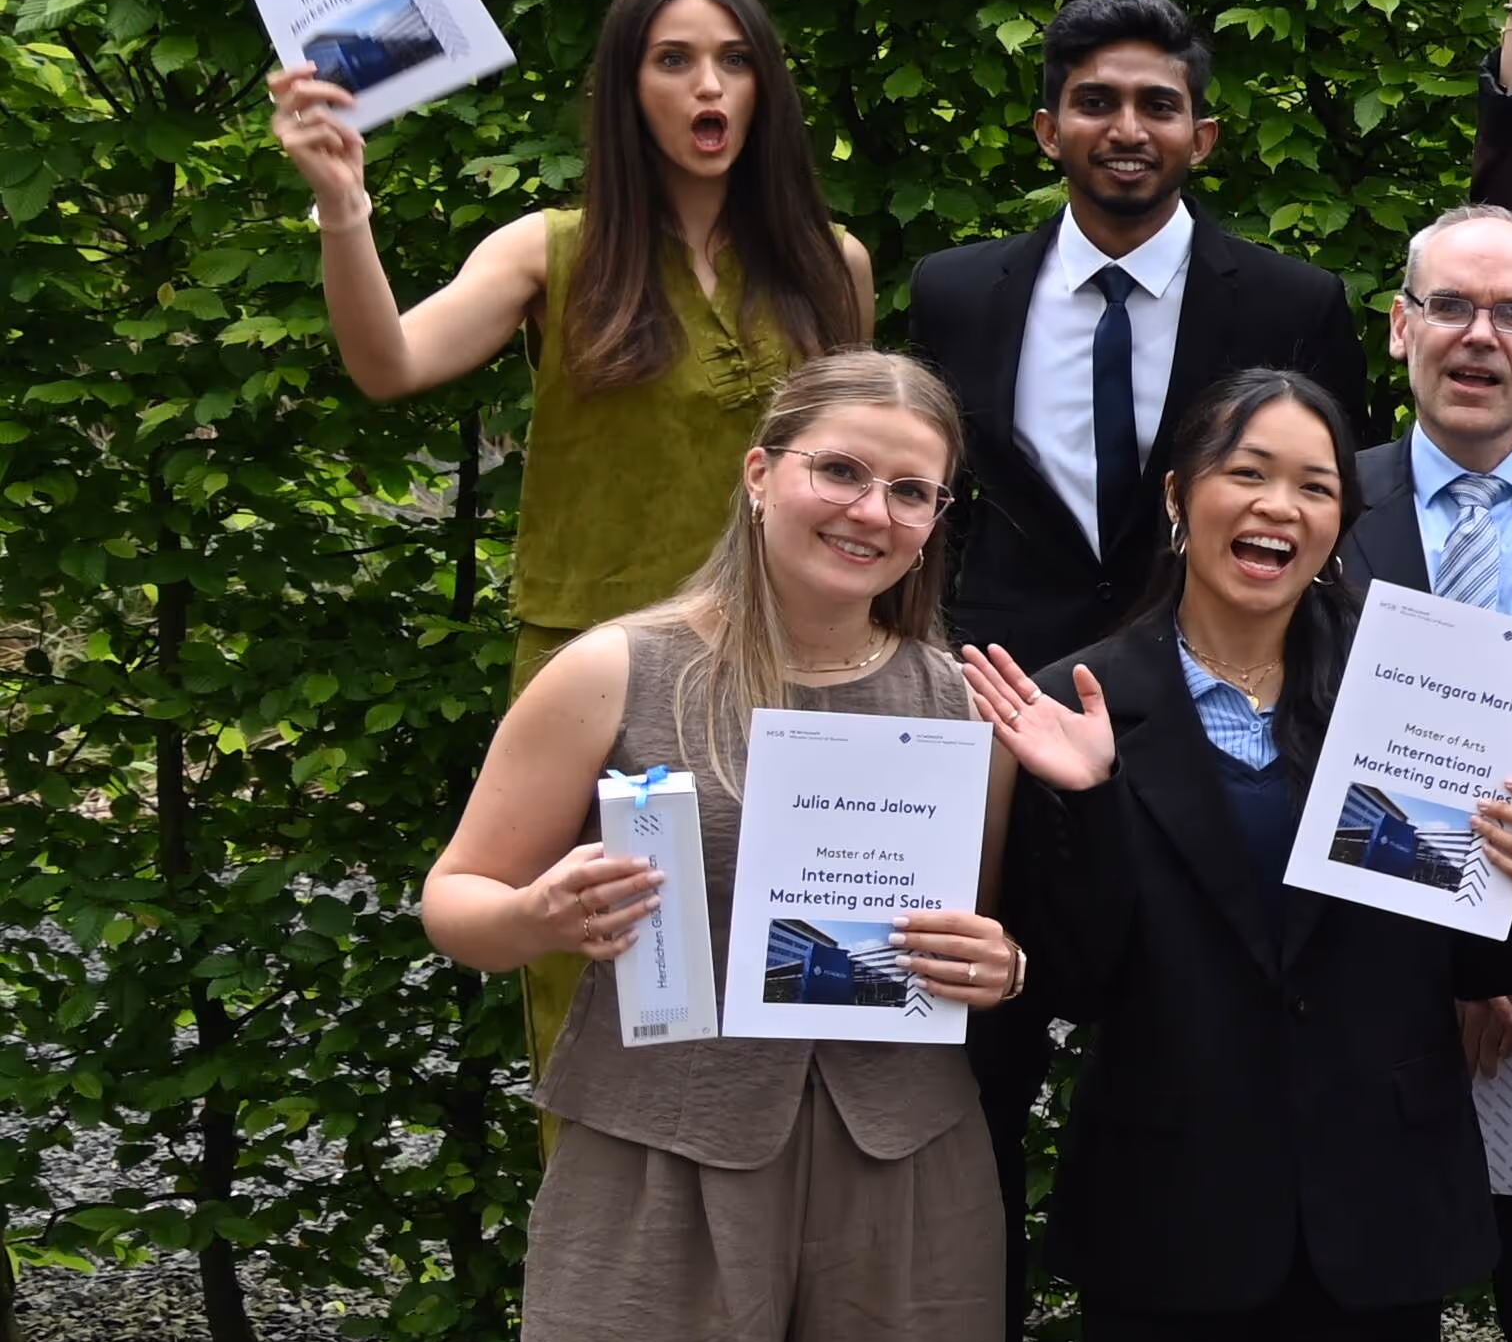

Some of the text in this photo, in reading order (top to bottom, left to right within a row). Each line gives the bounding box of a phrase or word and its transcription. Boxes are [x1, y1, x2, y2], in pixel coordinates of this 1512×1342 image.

[1374, 663, 1415, 686] Laica
[1420, 674, 1477, 702] Vergara
[1404, 722, 1486, 754] Master of Arts
[1353, 753, 1435, 790] Marketing
[1438, 779, 1471, 795] and
[1386, 739, 1493, 779] International
[792, 794, 937, 820] Julia Anna Jalowy
[816, 846, 905, 862] Master of Arts
[801, 867, 915, 887] International
[769, 888, 942, 911] Marketing and Sales
[655, 930, 668, 989] Herzlichen
